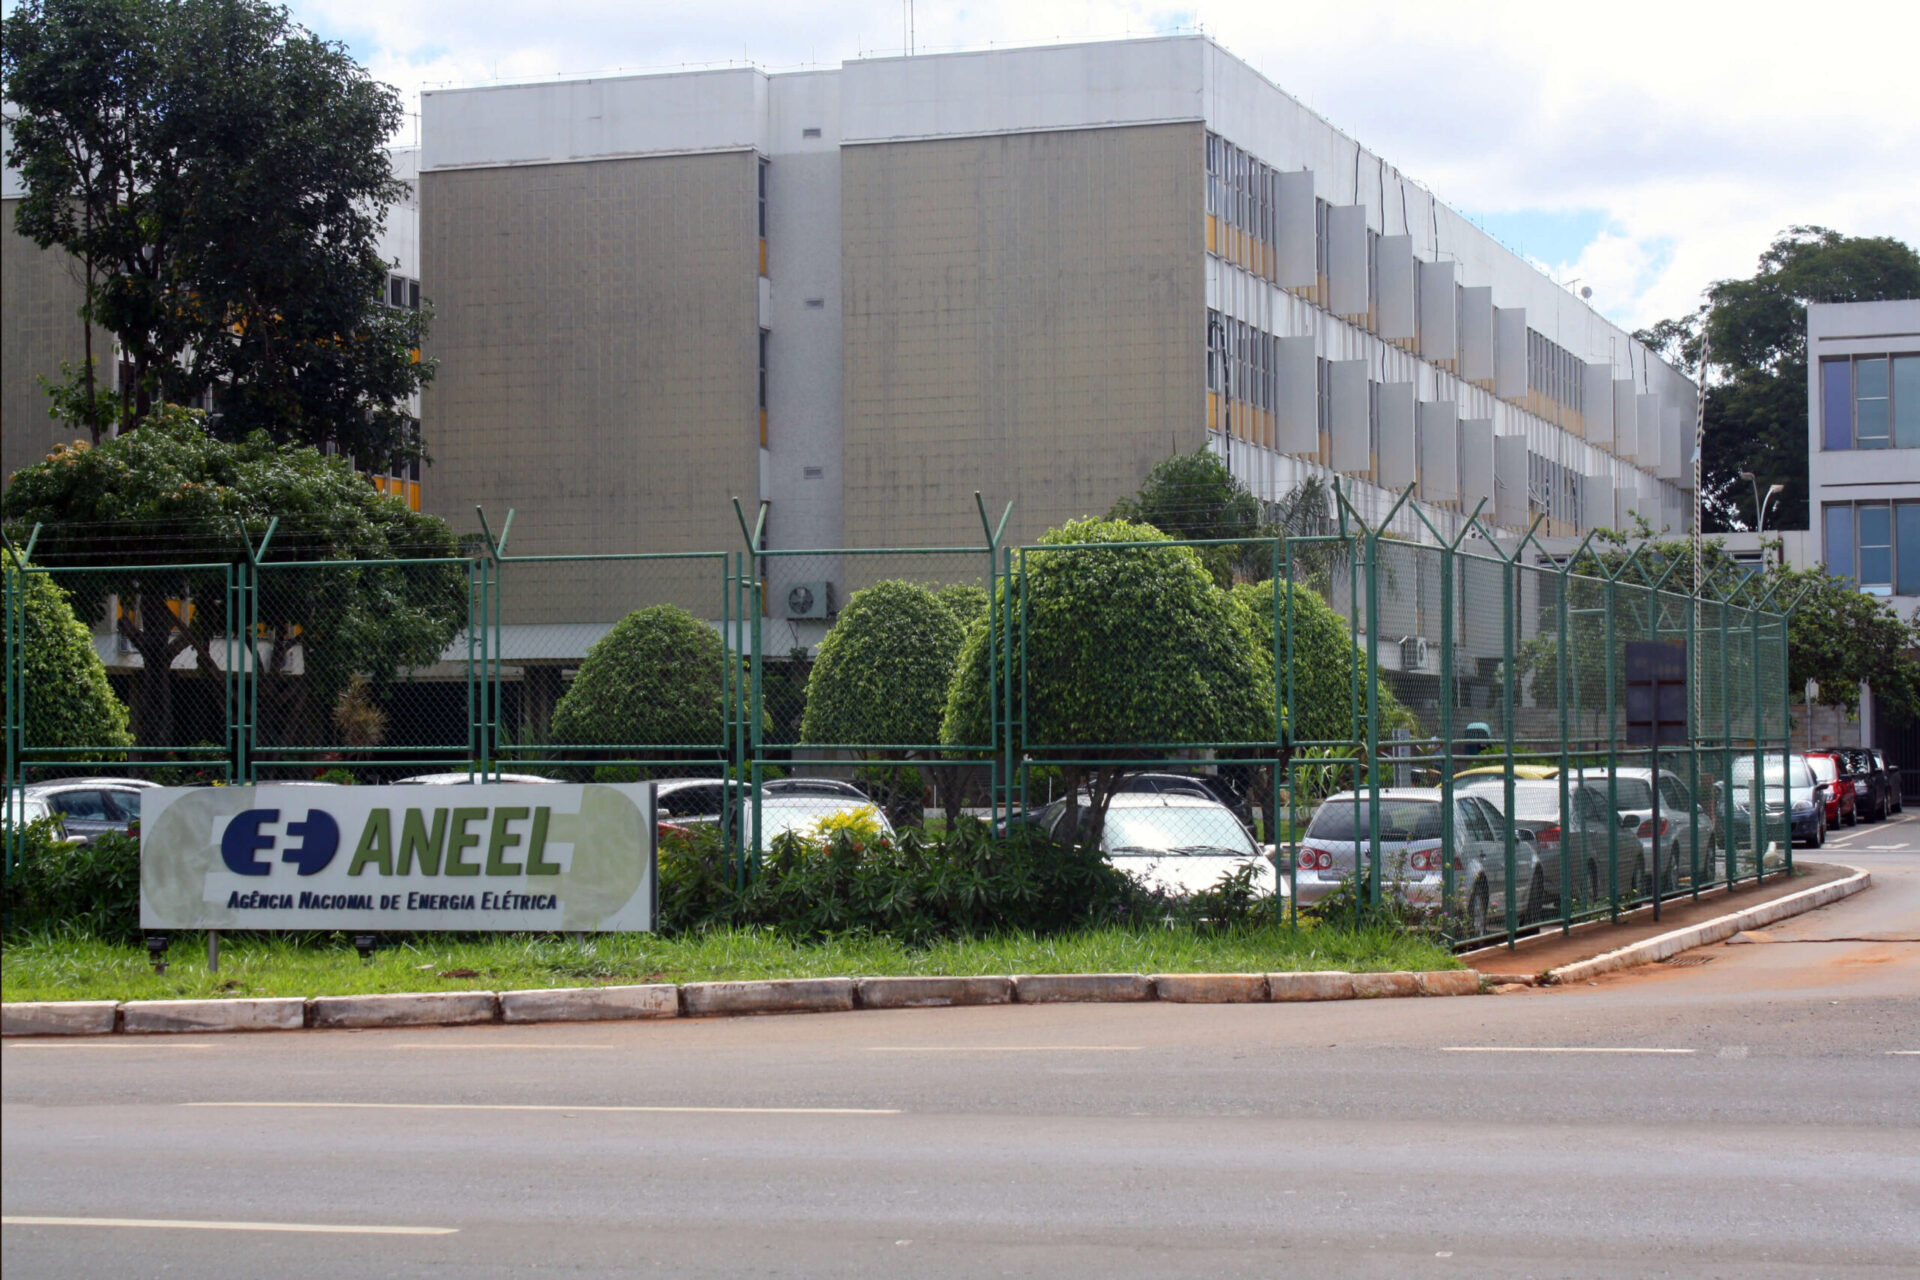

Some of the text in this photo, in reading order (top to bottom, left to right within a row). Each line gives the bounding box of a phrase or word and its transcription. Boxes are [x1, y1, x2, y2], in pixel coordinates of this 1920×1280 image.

[348, 806, 561, 876] ANEEL
[227, 890, 557, 910] AGÊNCIA NACIONAL DE ENERGIA ELÉTRICA
